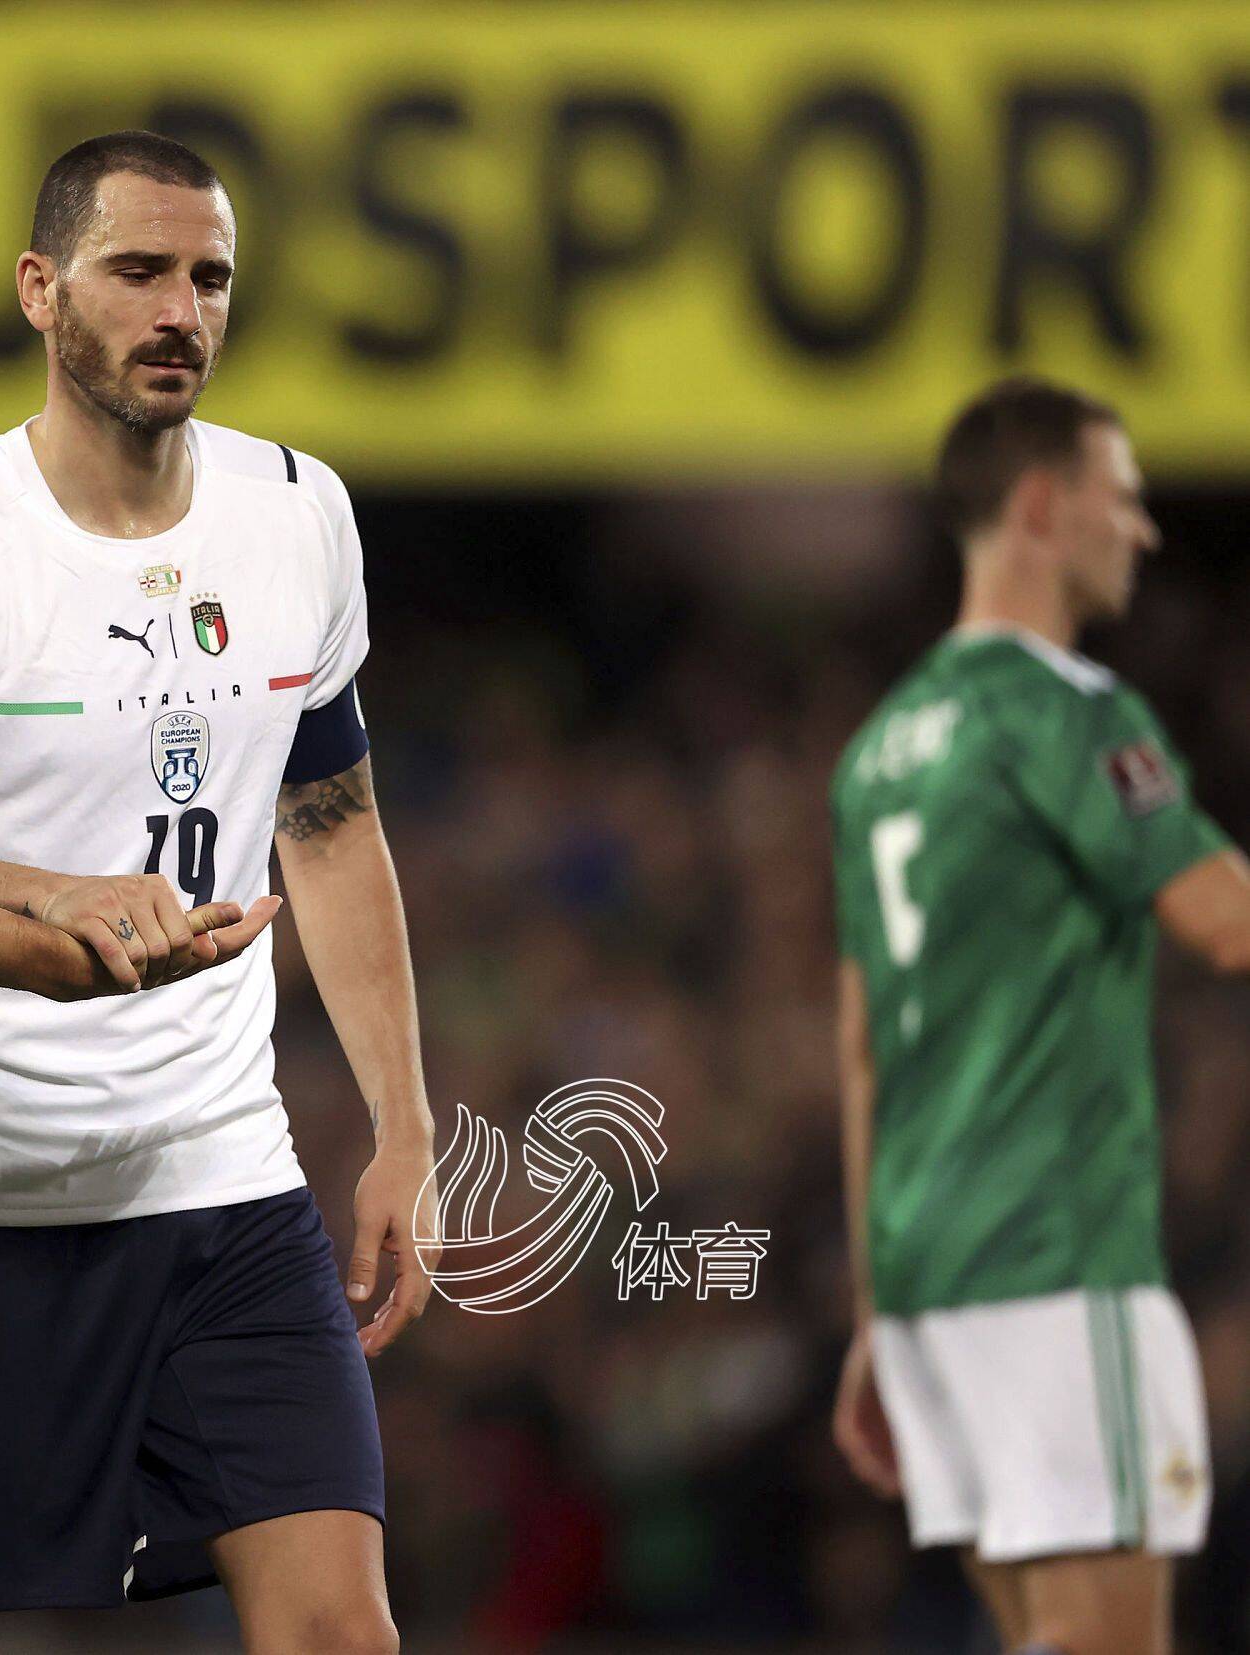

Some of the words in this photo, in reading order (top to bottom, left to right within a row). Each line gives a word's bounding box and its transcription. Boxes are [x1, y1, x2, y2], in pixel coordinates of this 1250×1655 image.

[193, 605, 221, 617] ITALIA
[118, 684, 241, 712] ITALIA
[168, 716, 192, 726] UEFA
[161, 728, 201, 737] EUROPEAN
[161, 736, 201, 745] CHAMPIONS
[171, 783, 191, 792] 2020
